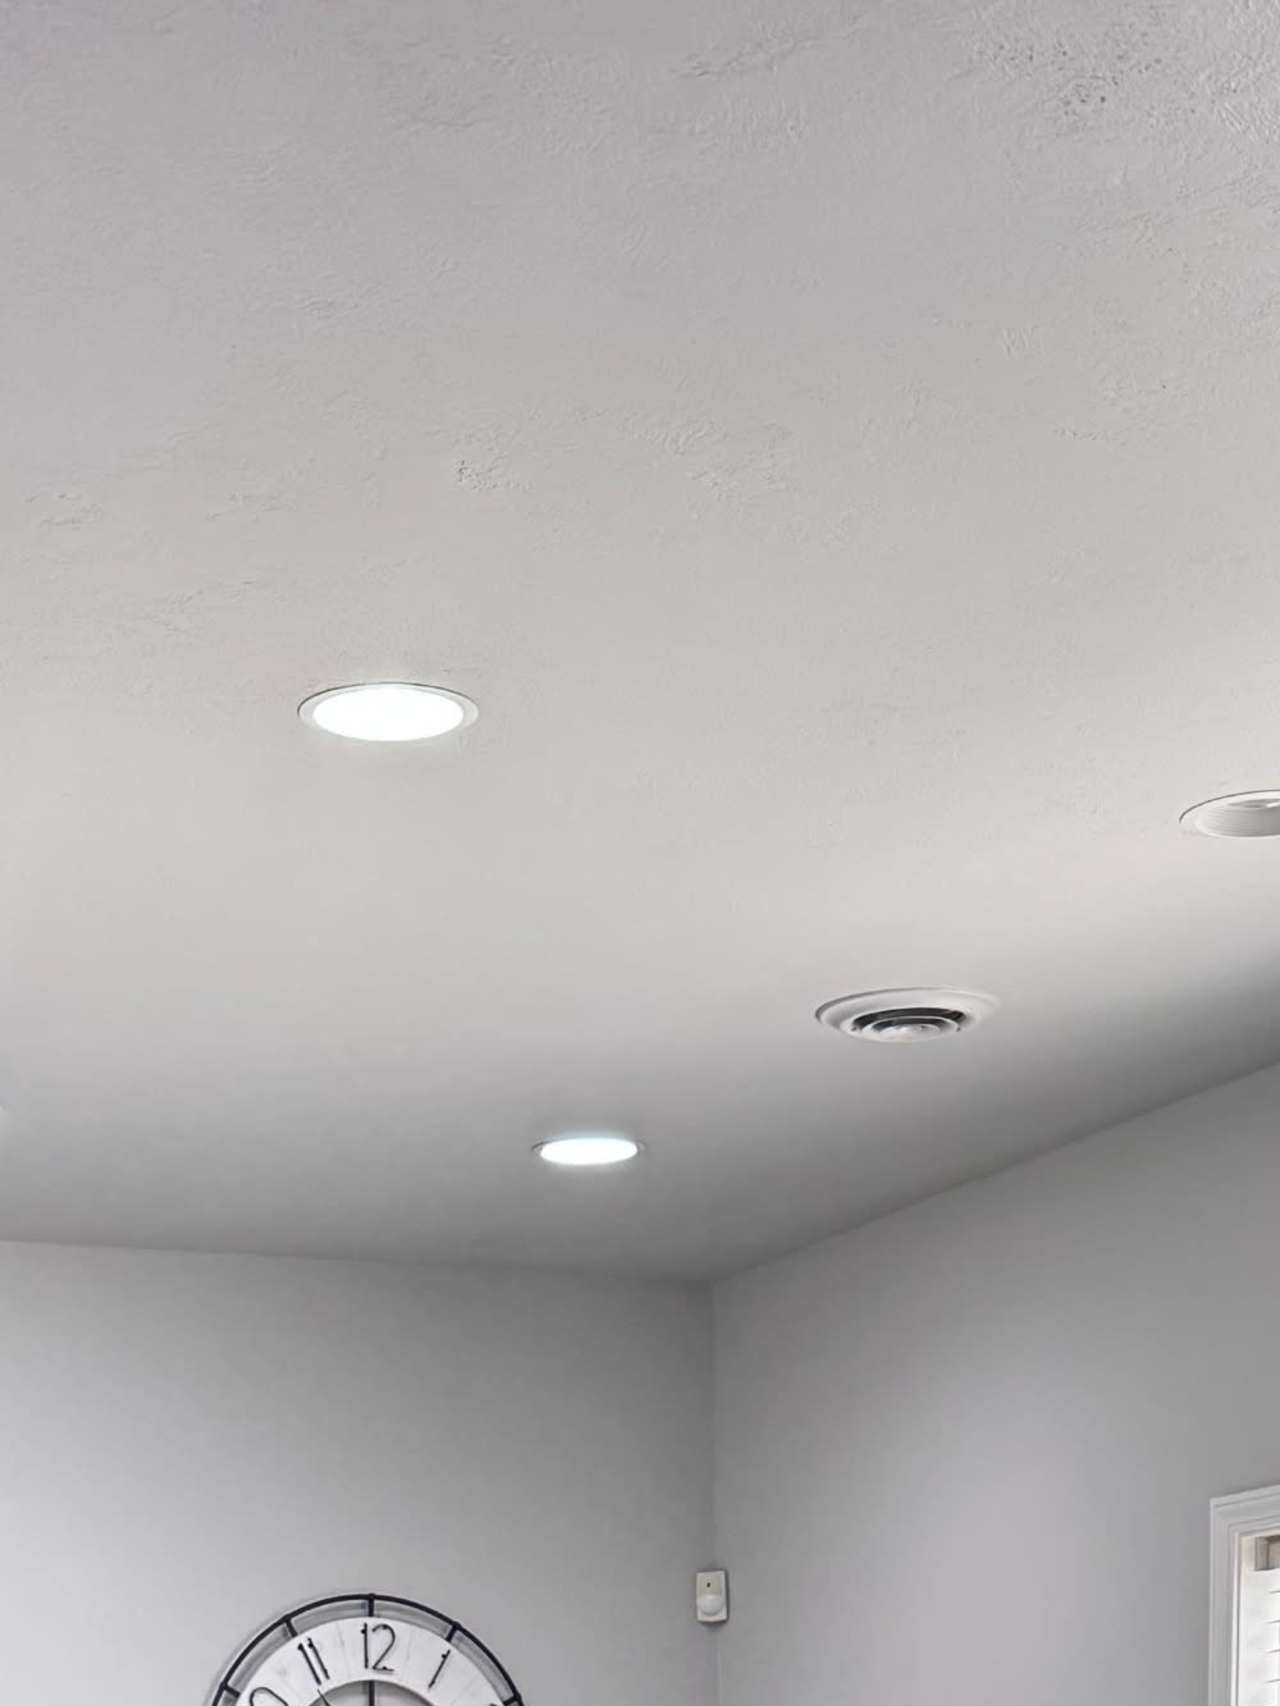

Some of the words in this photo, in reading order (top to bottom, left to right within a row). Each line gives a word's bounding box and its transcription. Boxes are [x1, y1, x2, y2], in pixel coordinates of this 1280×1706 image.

[297, 1637, 330, 1686] 11
[361, 1623, 395, 1673] 12
[428, 1649, 451, 1688] 1
